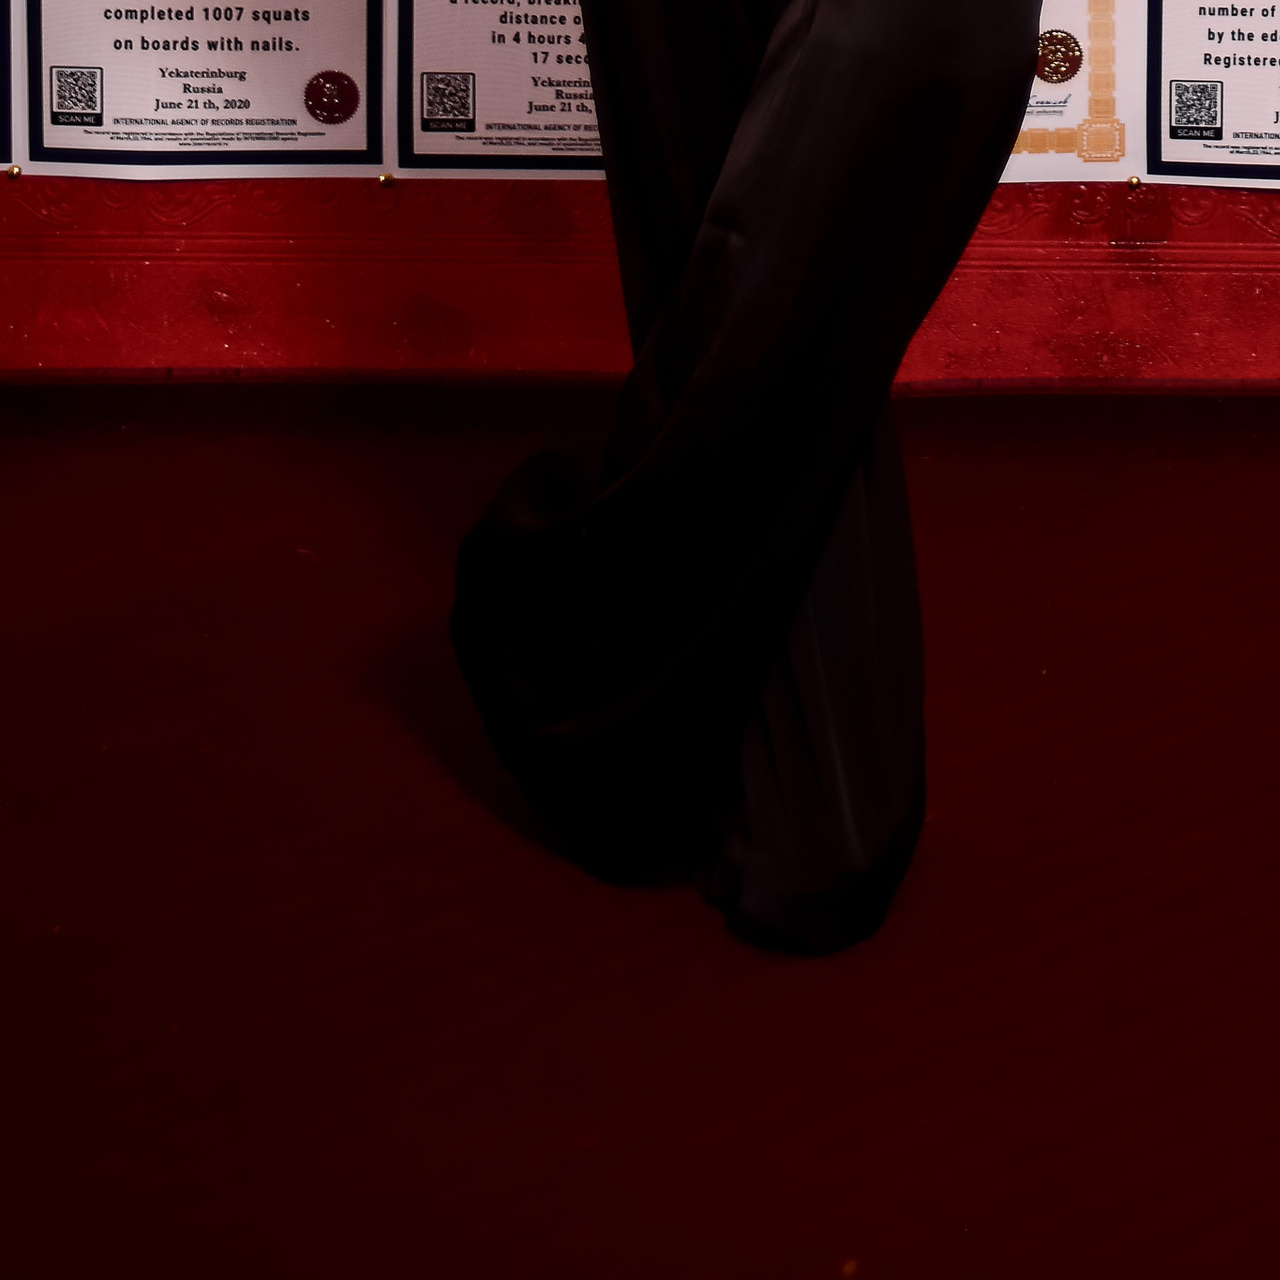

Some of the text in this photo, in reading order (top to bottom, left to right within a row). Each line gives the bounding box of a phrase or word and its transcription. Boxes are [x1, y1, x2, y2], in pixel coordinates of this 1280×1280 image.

[103, 5, 310, 24] completed 1007 squats
[499, 11, 567, 26] distance
[113, 35, 300, 51] on boards with nails.
[1177, 128, 1216, 138] SCAN ME
